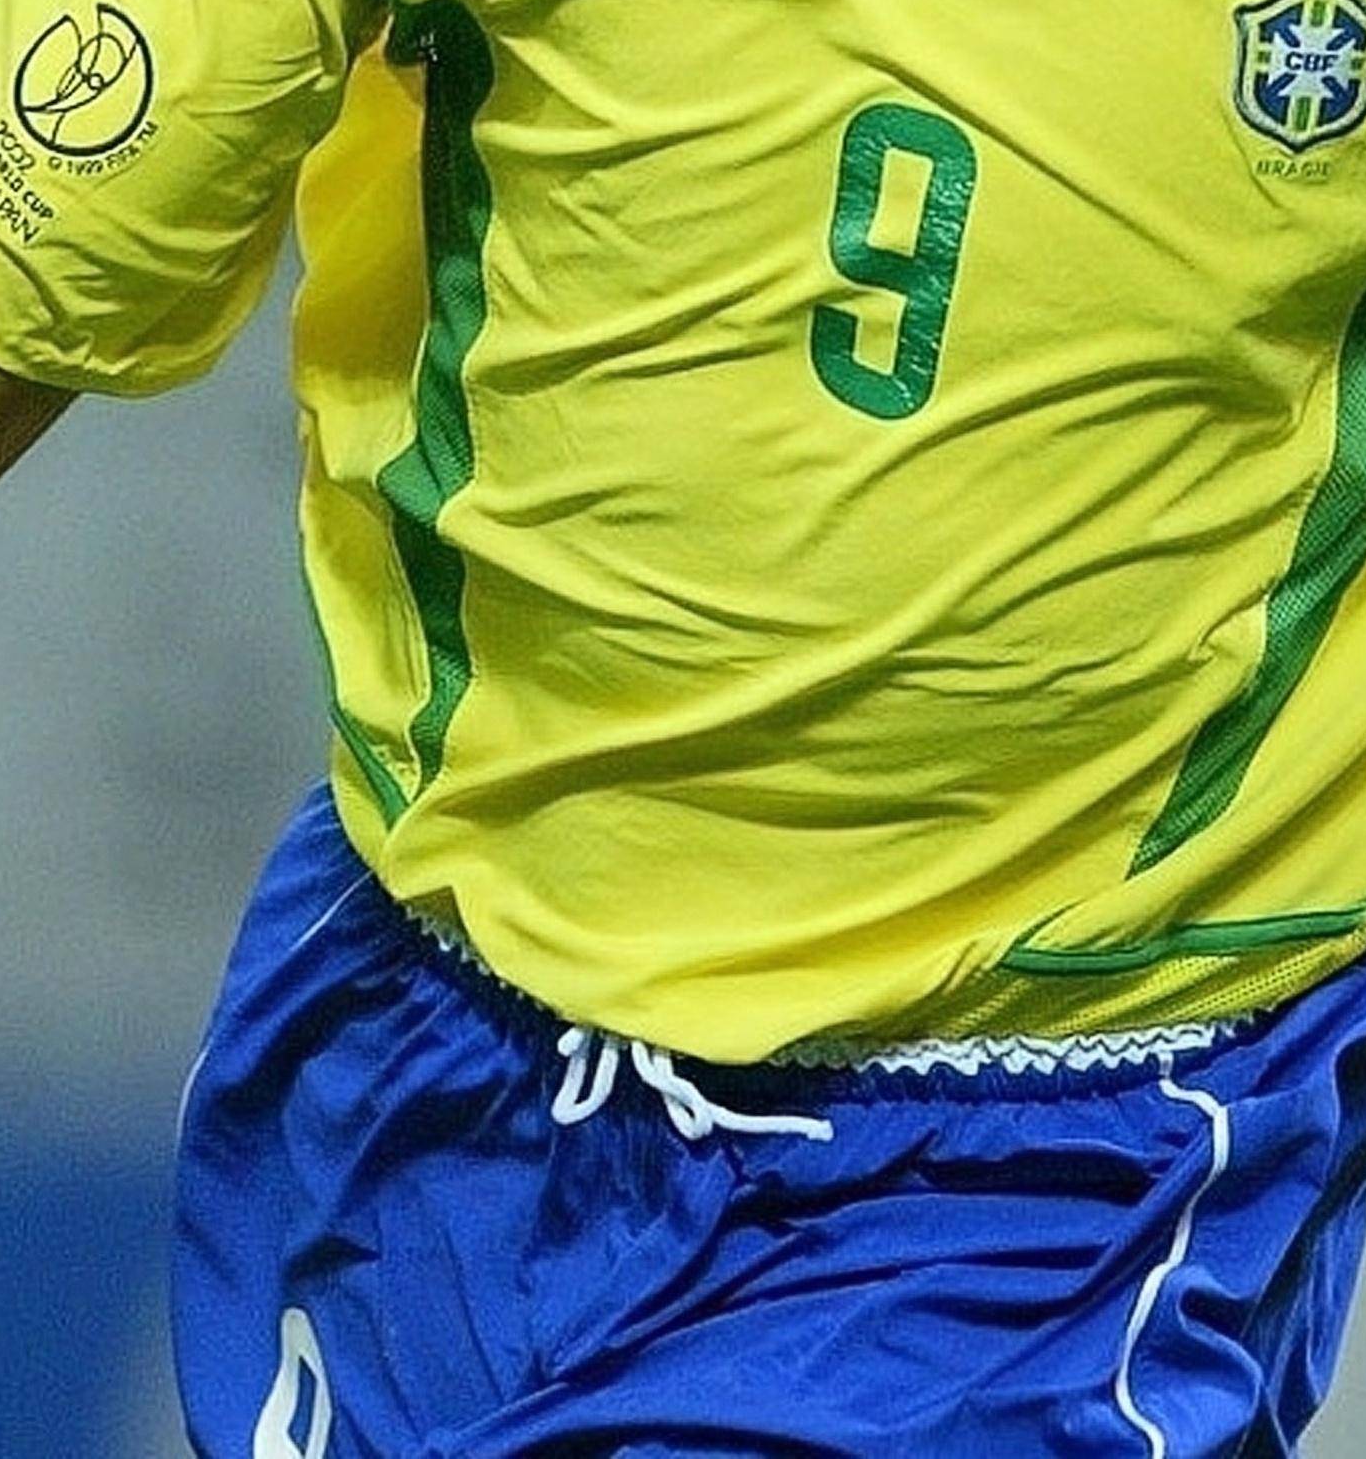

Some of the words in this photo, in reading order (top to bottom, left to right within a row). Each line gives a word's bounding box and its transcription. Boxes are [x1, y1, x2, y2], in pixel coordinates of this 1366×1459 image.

[1284, 51, 1339, 72] CBF
[21, 190, 54, 219] CUP
[810, 102, 978, 421] 9
